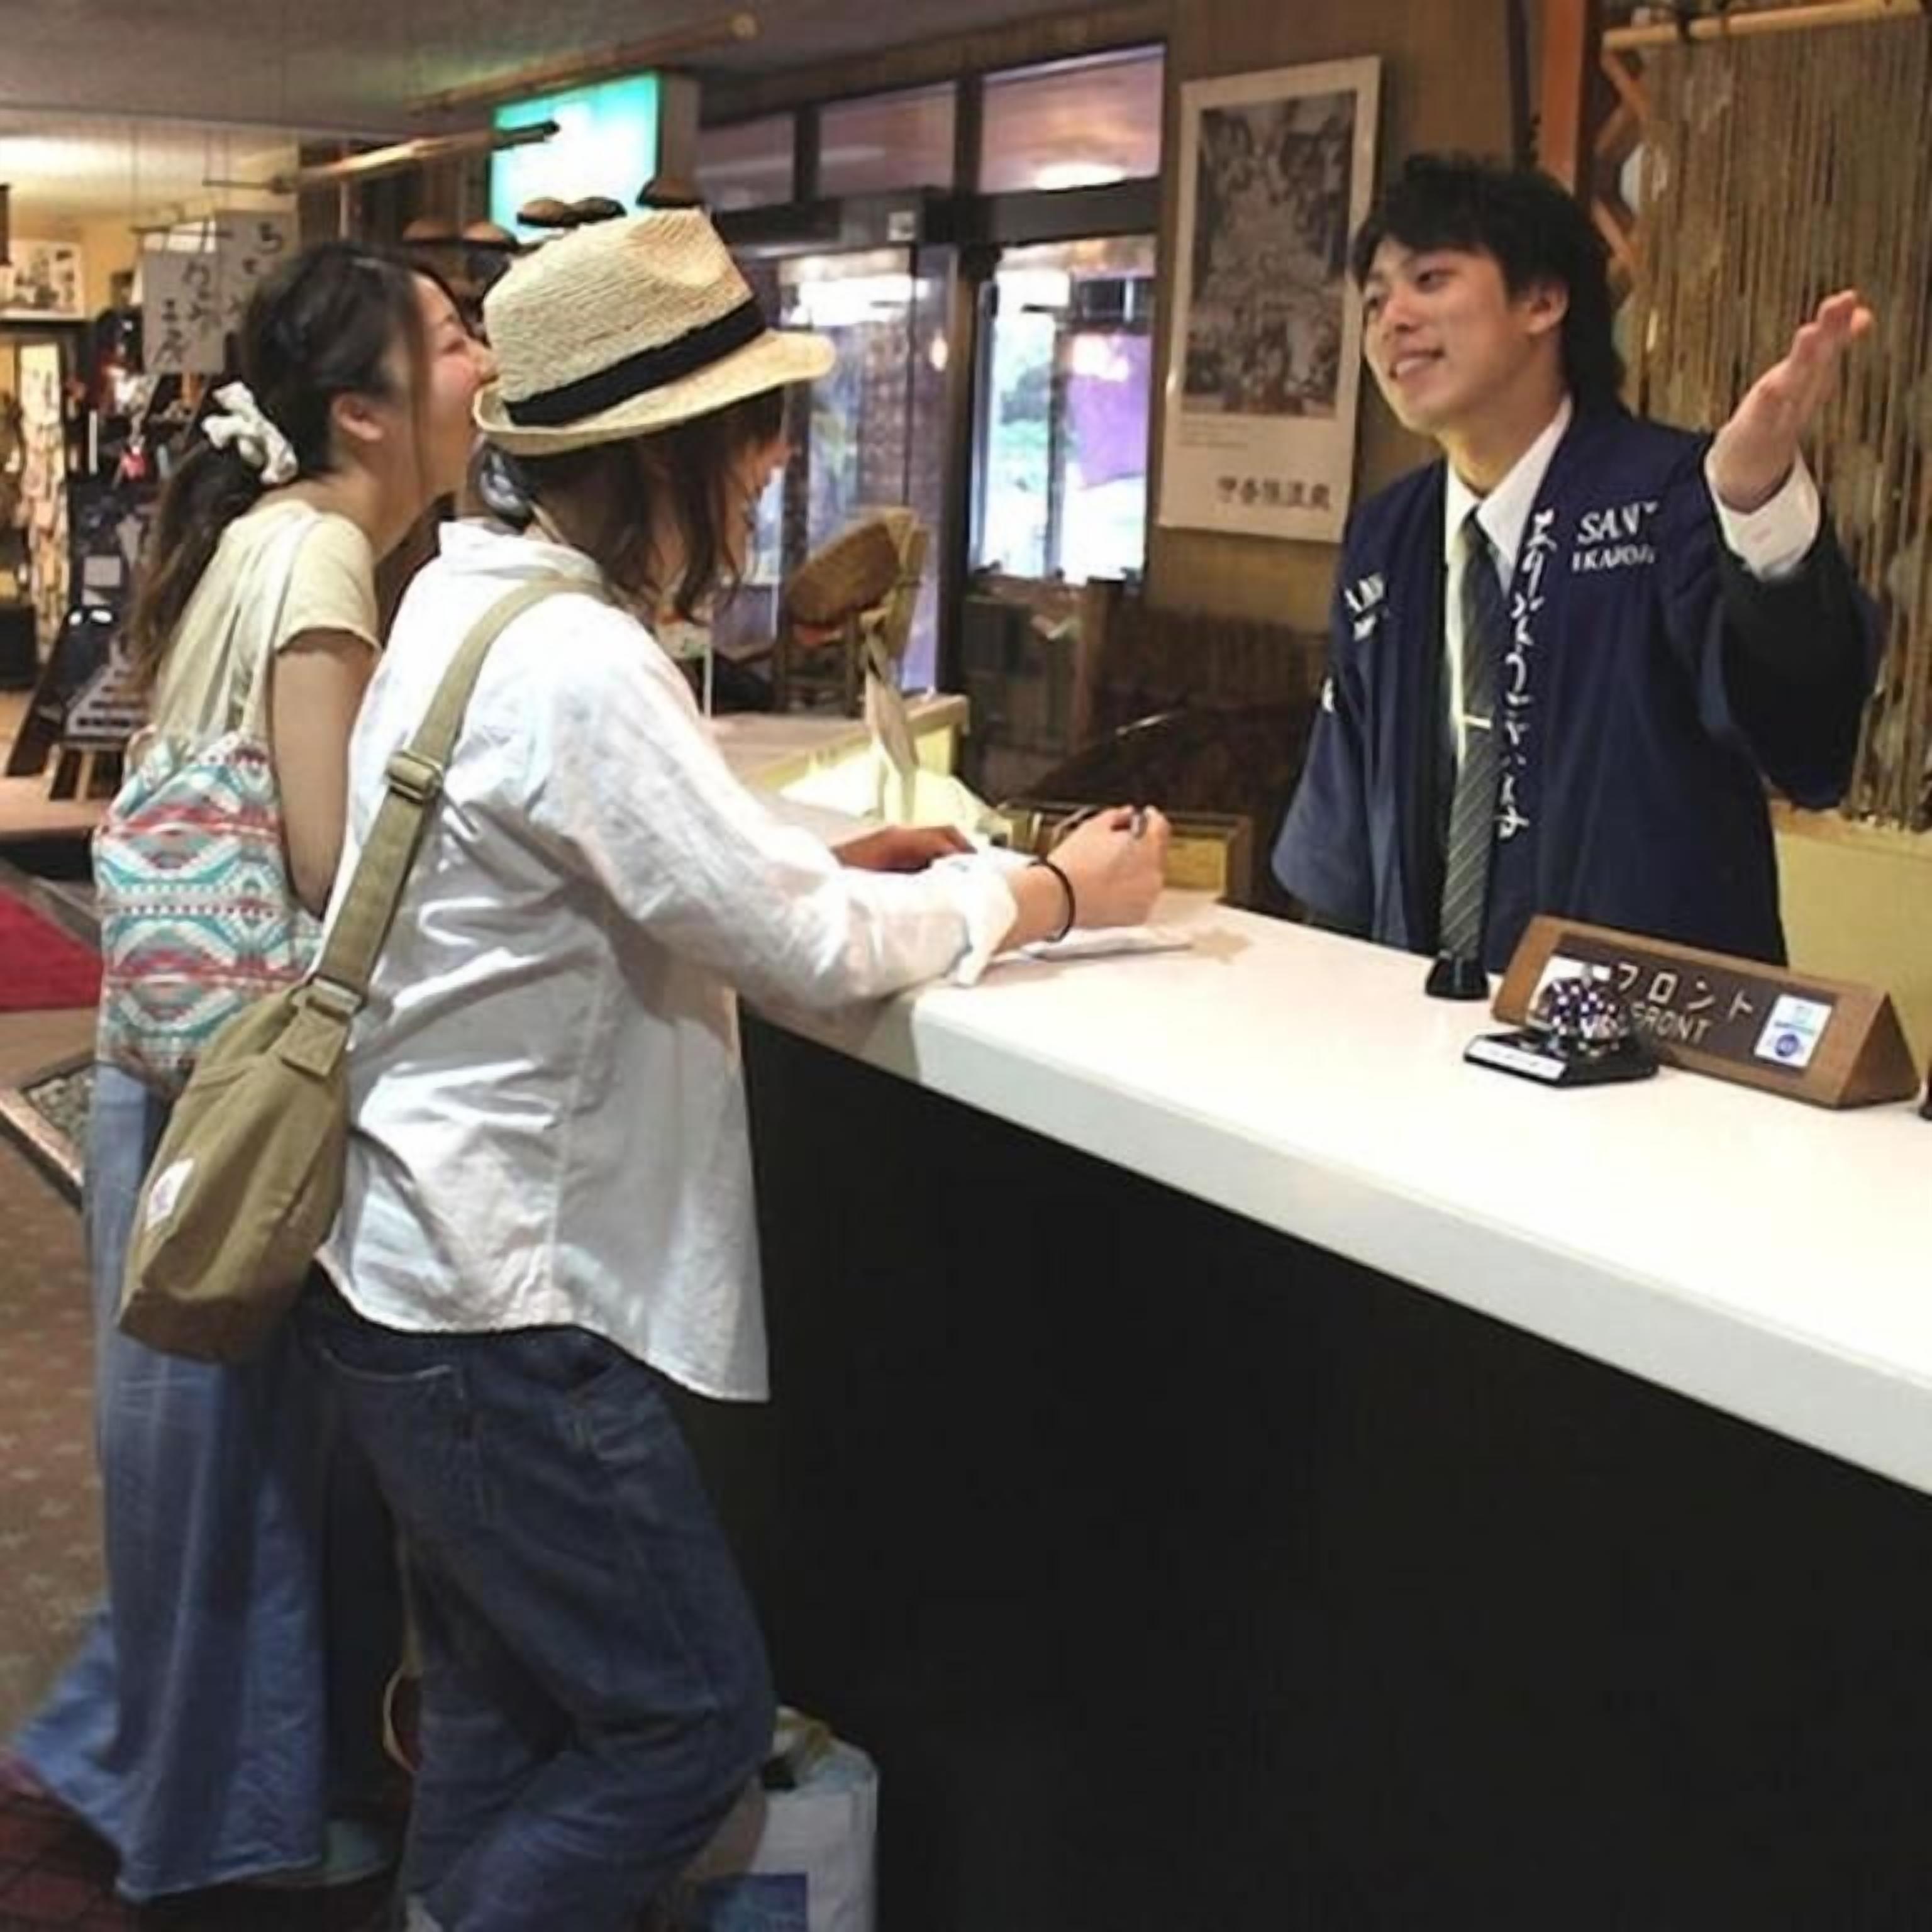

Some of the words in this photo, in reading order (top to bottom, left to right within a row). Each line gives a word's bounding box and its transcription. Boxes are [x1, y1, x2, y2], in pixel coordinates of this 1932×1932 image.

[1618, 962, 1753, 1021] フロント
[1630, 1001, 1713, 1044] FRONT
